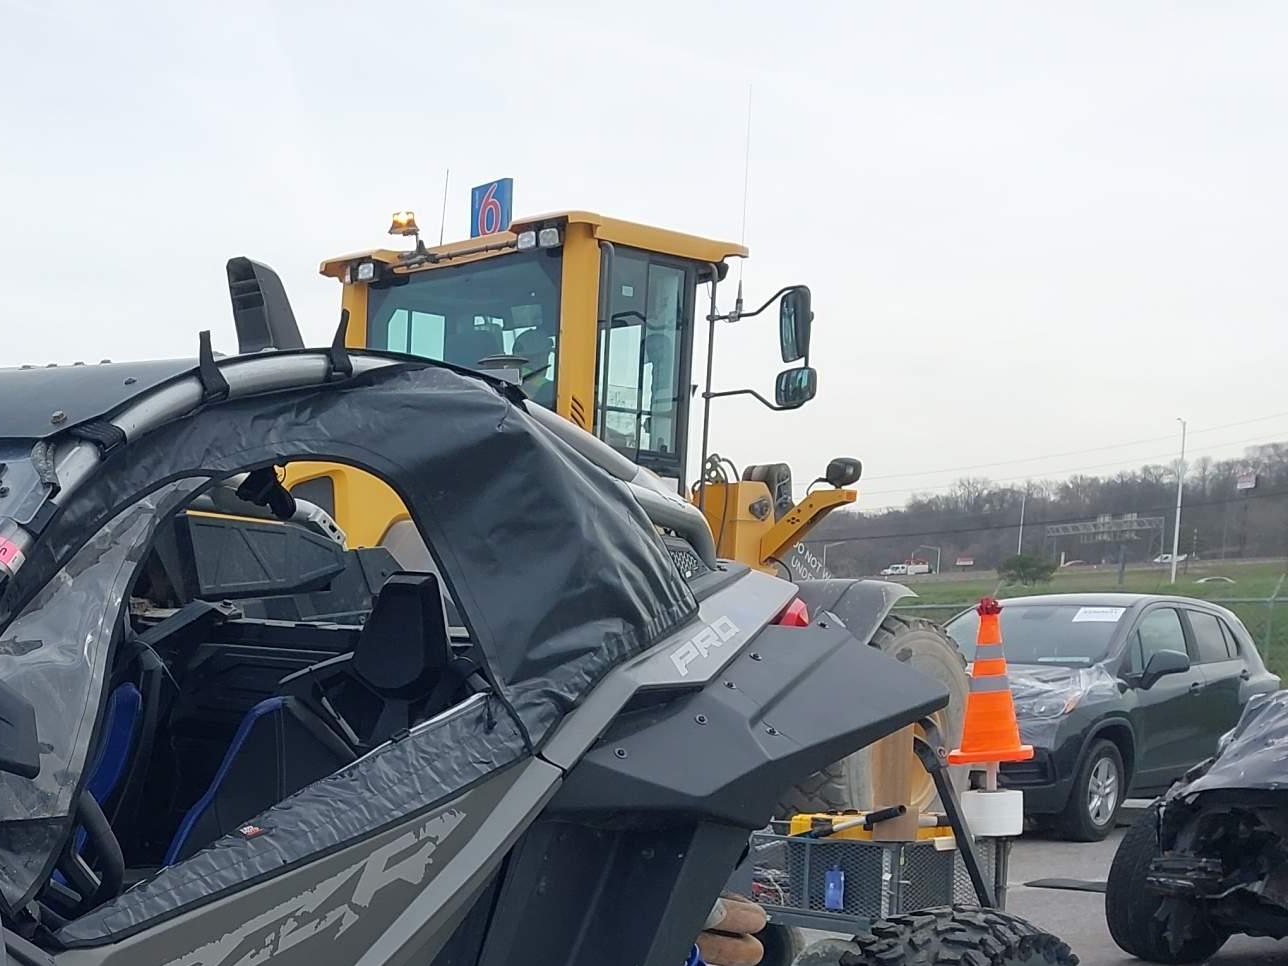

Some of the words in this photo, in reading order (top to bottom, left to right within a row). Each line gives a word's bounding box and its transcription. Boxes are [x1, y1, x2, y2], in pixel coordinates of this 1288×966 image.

[478, 183, 501, 237] 6
[804, 551, 822, 573] NOT
[670, 615, 740, 677] PRO
